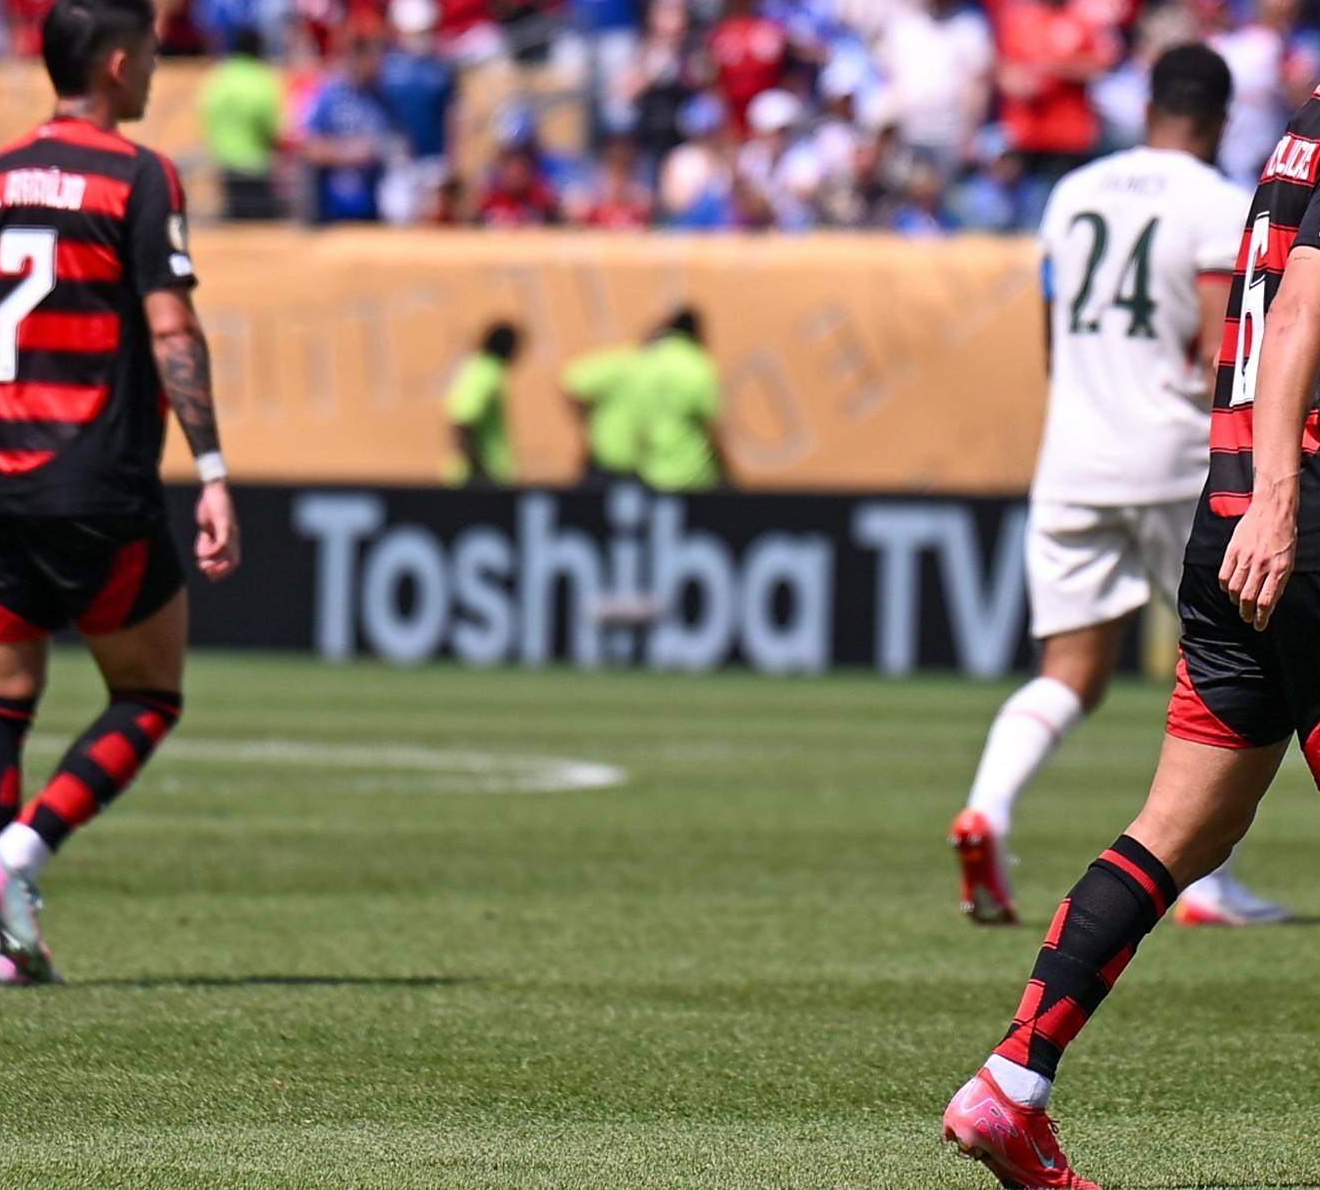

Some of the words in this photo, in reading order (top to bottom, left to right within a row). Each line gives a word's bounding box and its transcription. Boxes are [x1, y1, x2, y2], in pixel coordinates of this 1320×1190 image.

[1066, 209, 1162, 338] 24
[1229, 210, 1271, 408] 6
[293, 484, 834, 676] Toshiba
[855, 504, 1029, 679] TV
